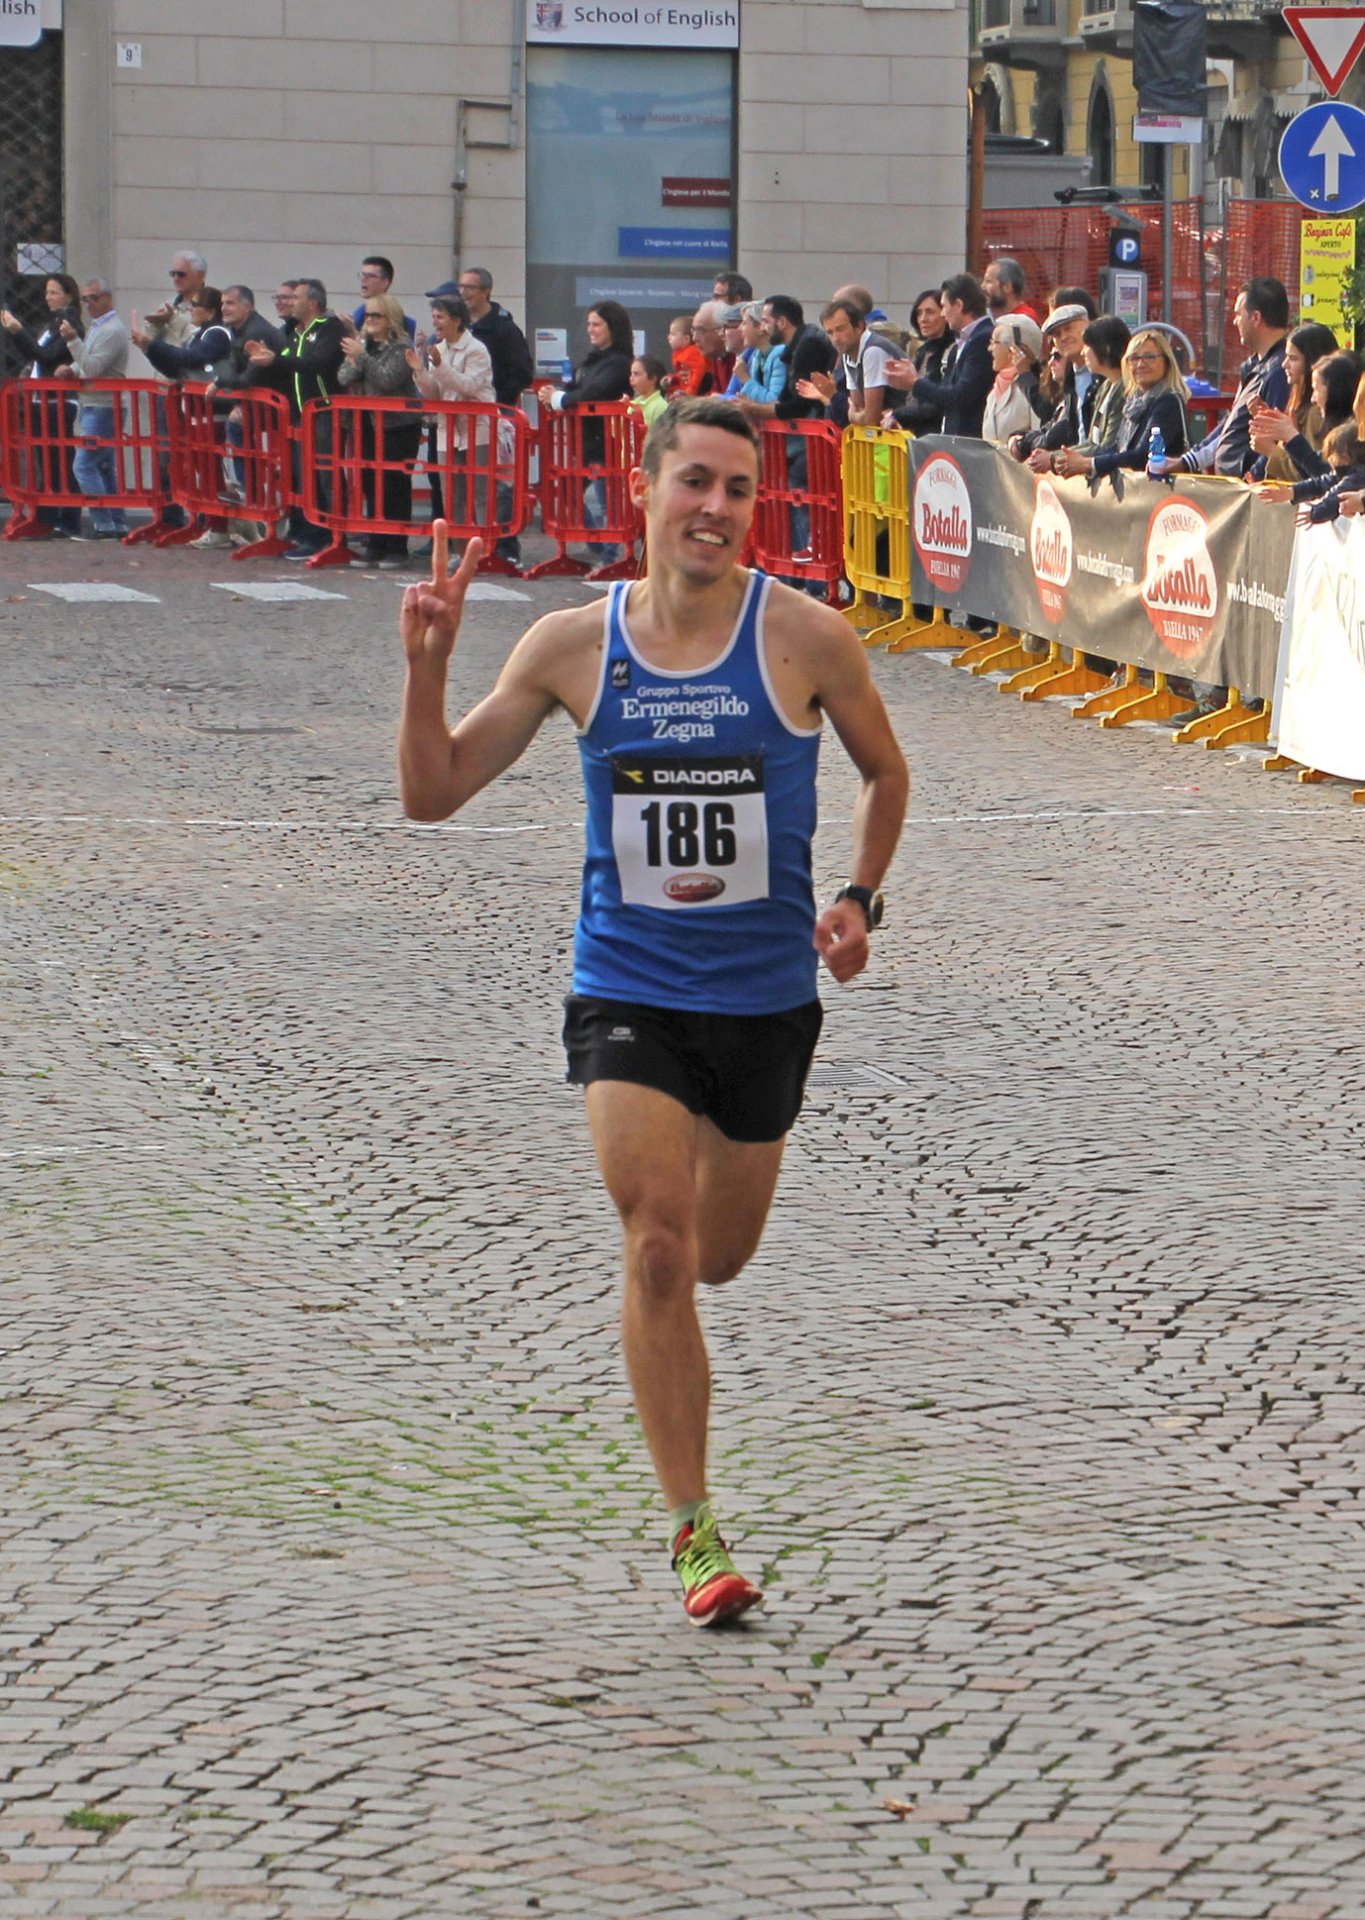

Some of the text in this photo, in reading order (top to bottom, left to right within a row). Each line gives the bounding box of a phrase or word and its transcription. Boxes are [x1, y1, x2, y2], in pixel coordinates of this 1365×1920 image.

[0, 0, 36, 15] lish
[574, 7, 736, 29] School of English
[126, 48, 133, 62] 9
[1122, 238, 1137, 261] P
[922, 503, 968, 550] Botalla
[1035, 527, 1067, 579] Botalla
[1147, 555, 1211, 611] Botalla
[637, 684, 731, 699] Gruppo Sportivo
[621, 696, 749, 720] Ermenegildo
[653, 719, 715, 743] Zegna
[653, 768, 756, 785] DIADORA
[640, 801, 737, 867] 186
